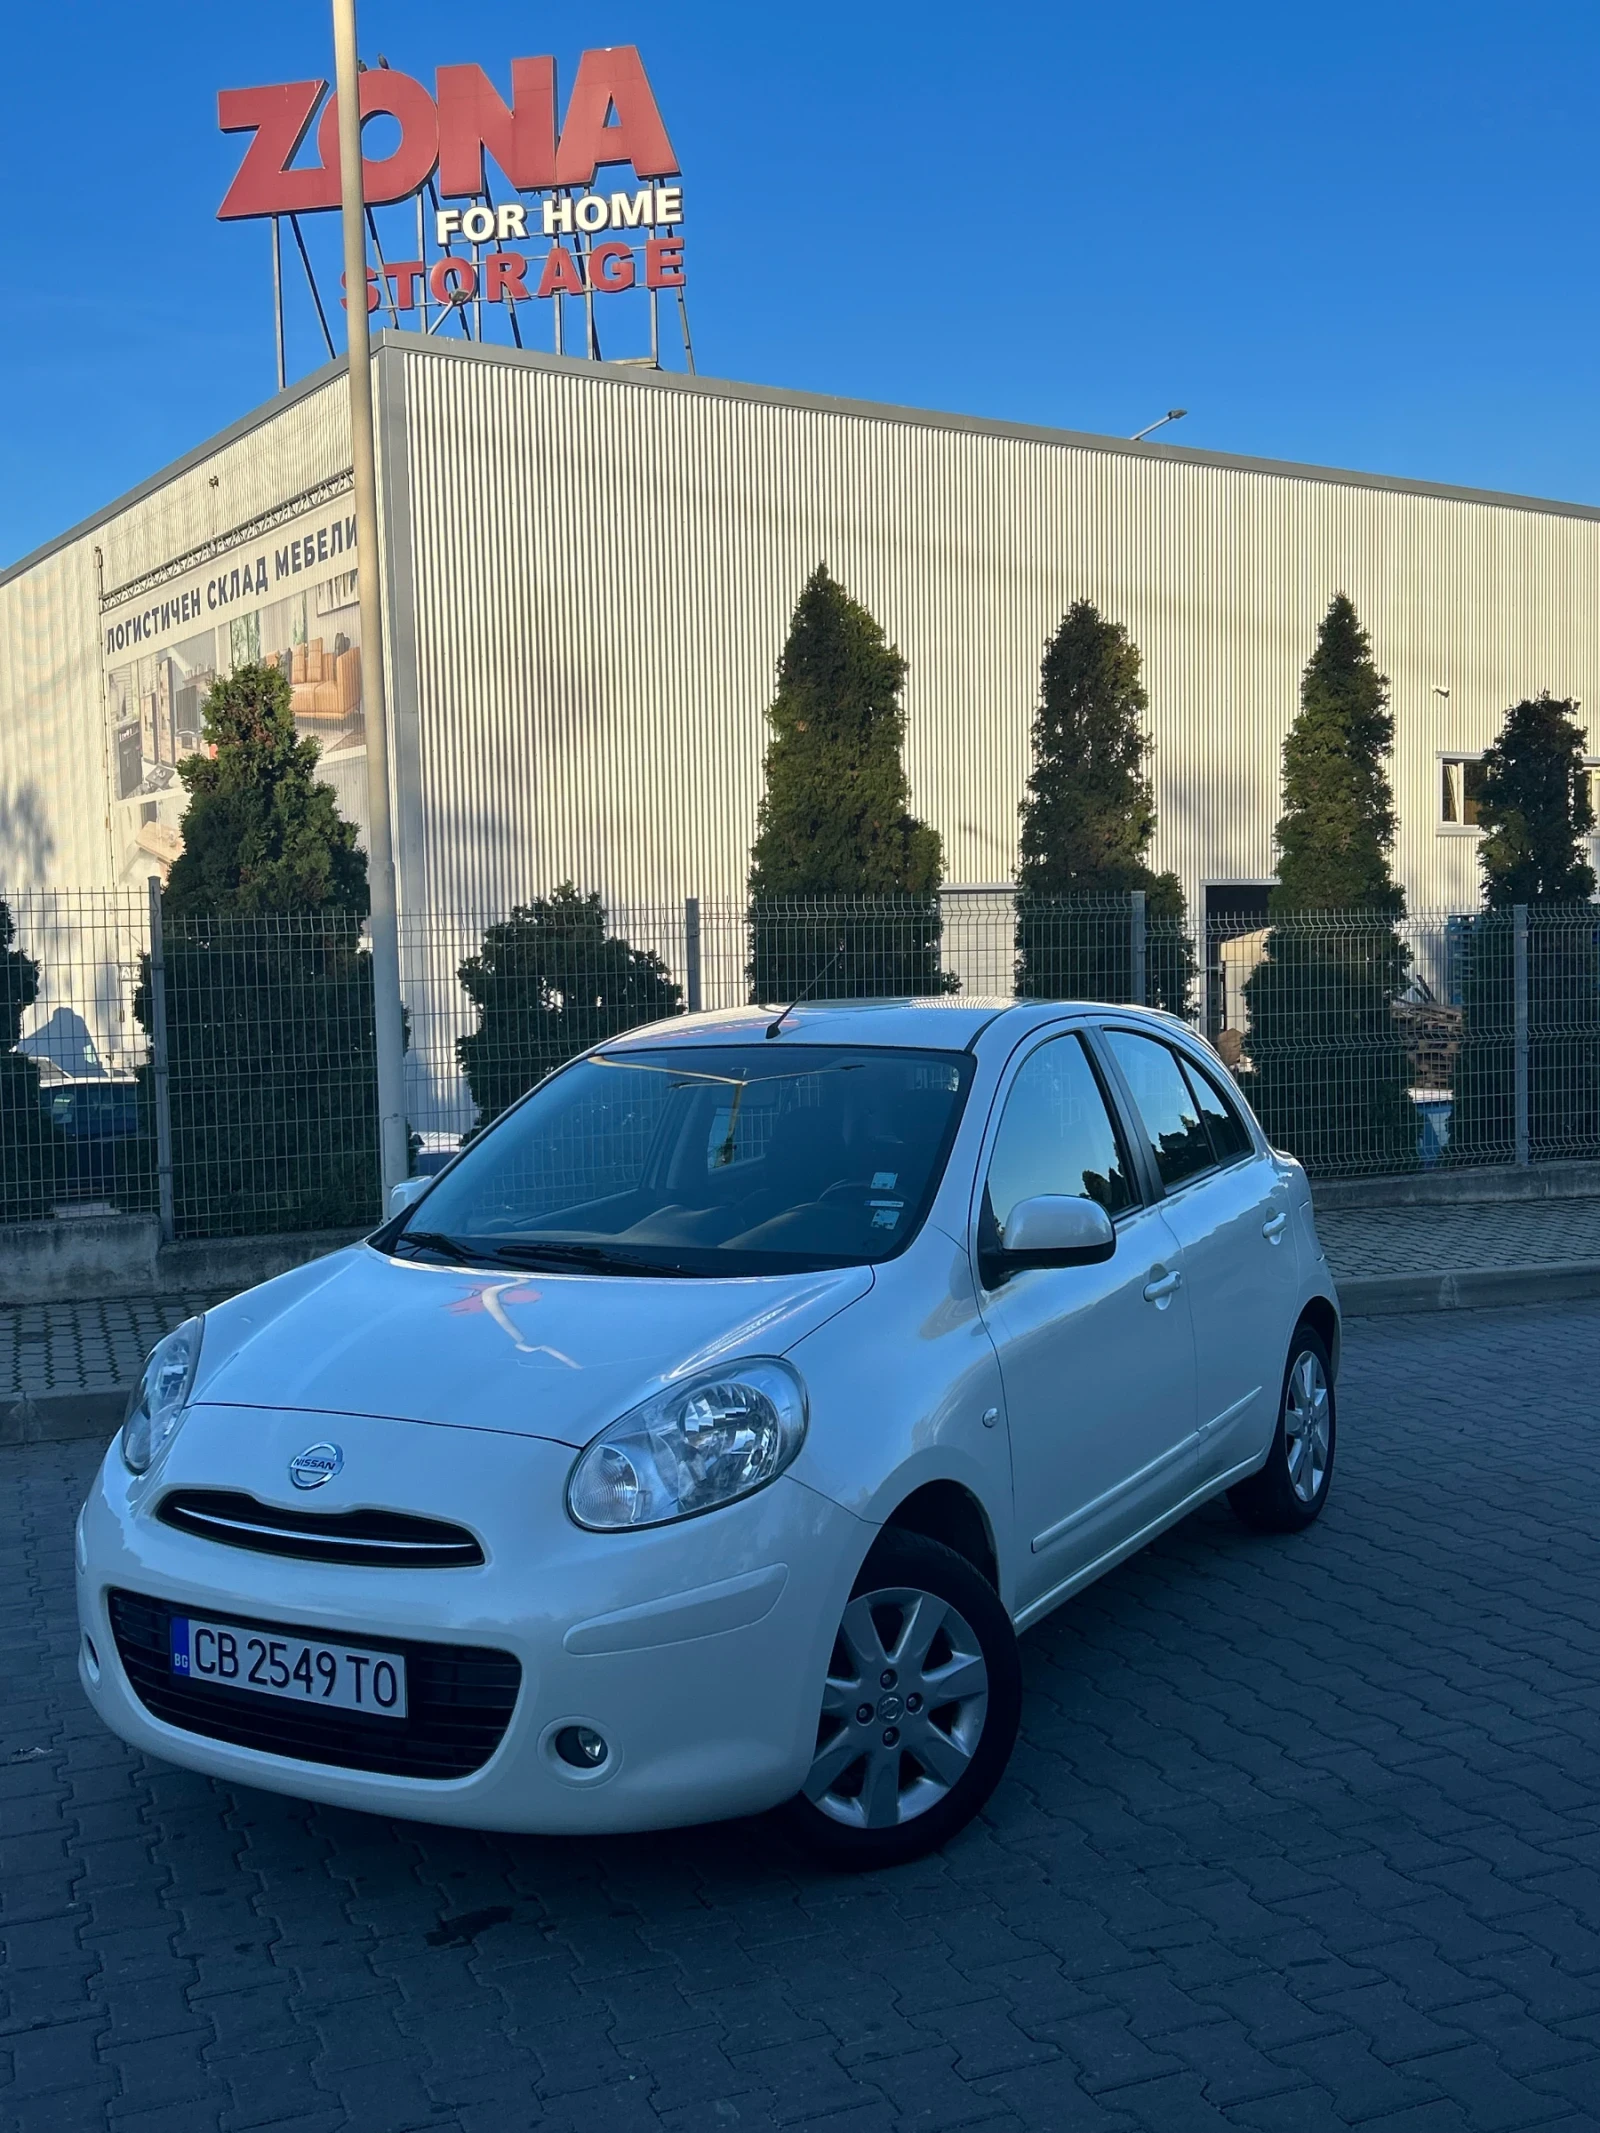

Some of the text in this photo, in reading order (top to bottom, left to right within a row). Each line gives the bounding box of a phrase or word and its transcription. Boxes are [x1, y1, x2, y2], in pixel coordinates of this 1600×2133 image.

[216, 45, 682, 221] ZONA
[436, 187, 684, 246] FOR HOME
[107, 514, 358, 655] ЛОГИСТИЧЕН СКЛАД МЕБЕЛИ
[294, 1458, 336, 1470] NISSAN
[174, 1653, 189, 1668] BG
[195, 1628, 239, 1678] CB
[247, 1638, 337, 1697] 2549
